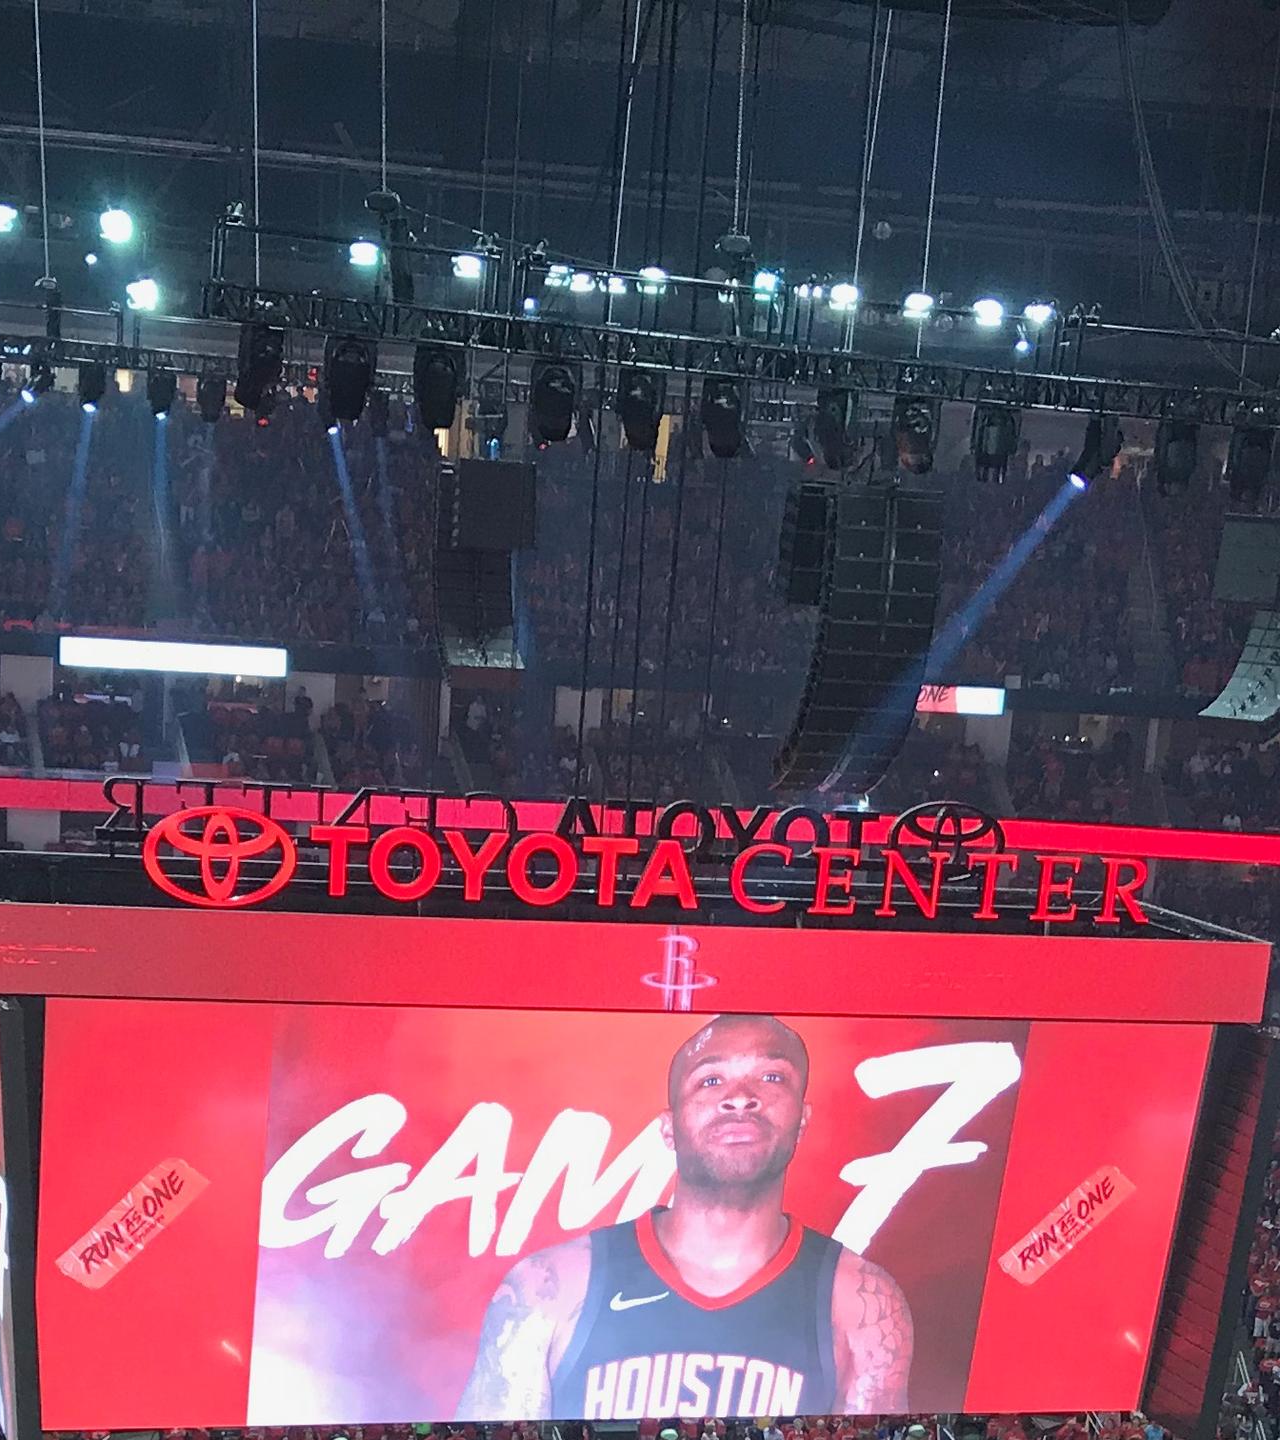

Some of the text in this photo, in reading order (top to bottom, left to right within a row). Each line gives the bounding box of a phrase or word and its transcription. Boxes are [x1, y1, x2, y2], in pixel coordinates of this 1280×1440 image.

[310, 824, 1150, 924] TOYOTA CENTER
[259, 1041, 1022, 1258] GAM 7
[78, 1222, 125, 1274] RUN
[142, 1169, 185, 1218] ONE
[1017, 1224, 1059, 1271] RUN
[1077, 1176, 1115, 1220] ONE
[584, 1352, 805, 1420] HOUSTON
